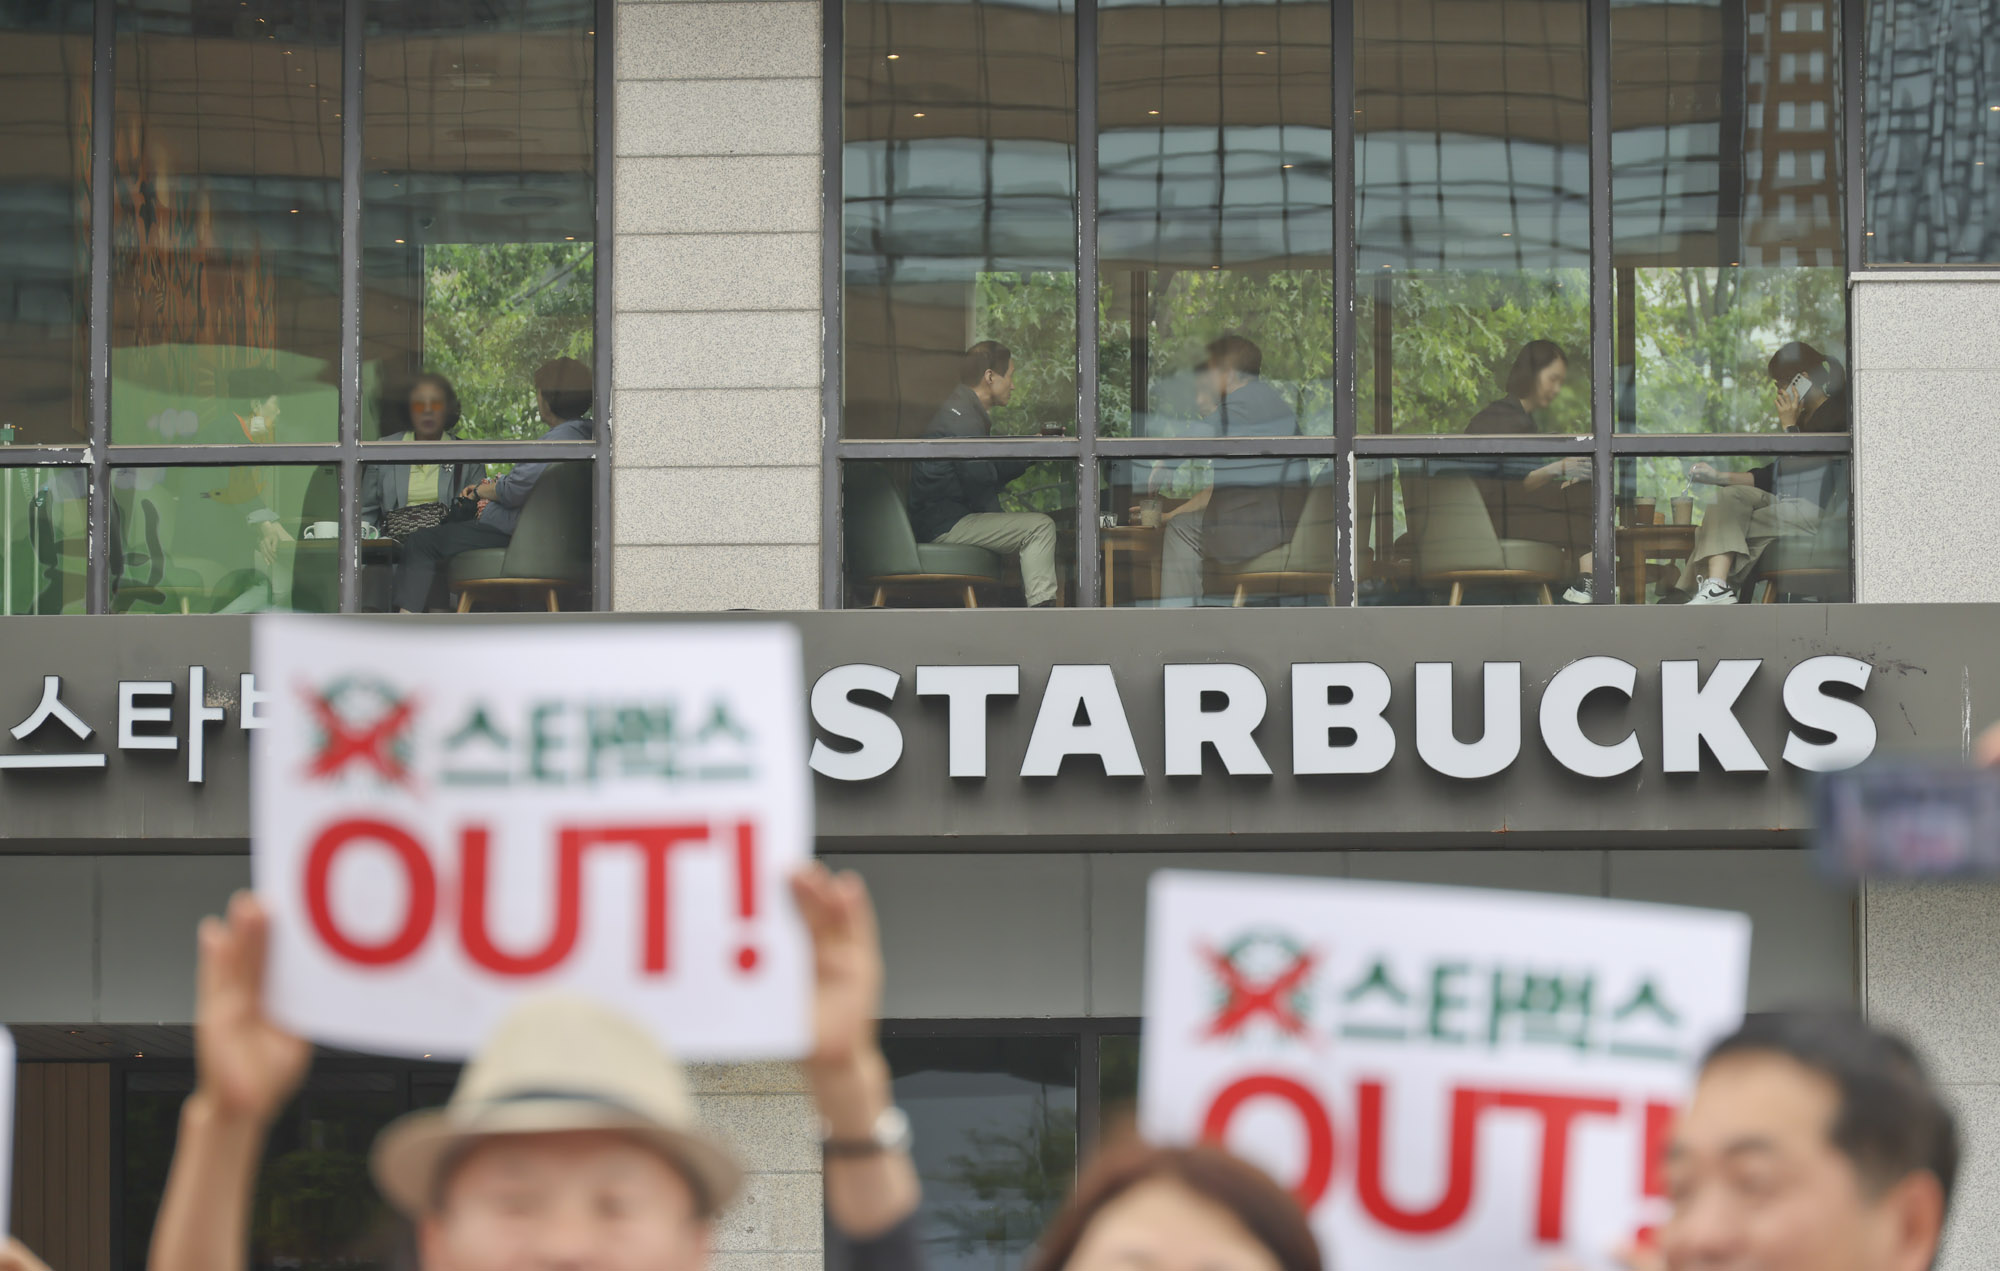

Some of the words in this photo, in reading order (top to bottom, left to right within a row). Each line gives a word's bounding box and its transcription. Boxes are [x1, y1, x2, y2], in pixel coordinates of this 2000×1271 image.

[0, 664, 262, 783] 스타
[441, 700, 752, 785] 스타벅스
[810, 656, 1878, 779] STARBUCKS
[303, 816, 757, 978] OUT!
[1339, 955, 1680, 1060] 스타벅스
